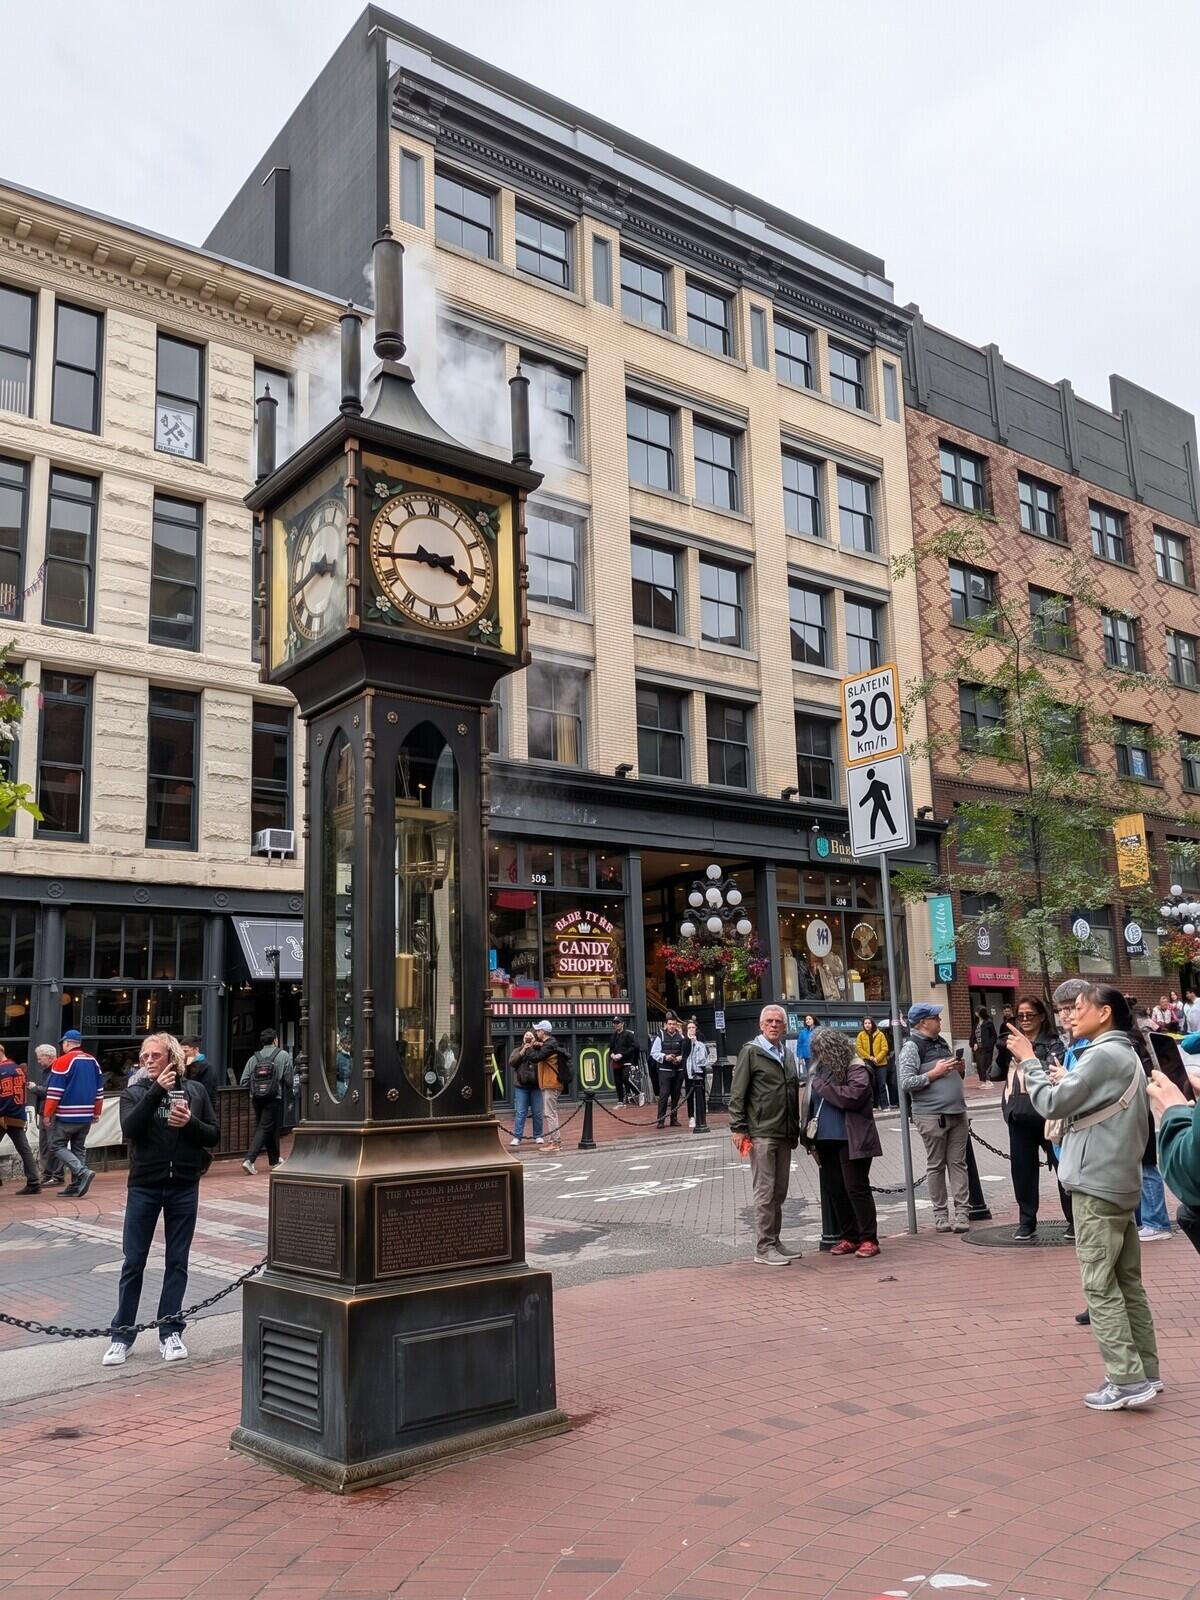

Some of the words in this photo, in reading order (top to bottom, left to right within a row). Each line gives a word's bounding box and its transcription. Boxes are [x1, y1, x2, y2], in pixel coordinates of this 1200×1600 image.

[850, 691, 892, 738] 30
[857, 734, 888, 754] km/h
[555, 911, 582, 931] OLDE
[559, 941, 611, 955] CANDY
[560, 958, 614, 972] SHOPPE
